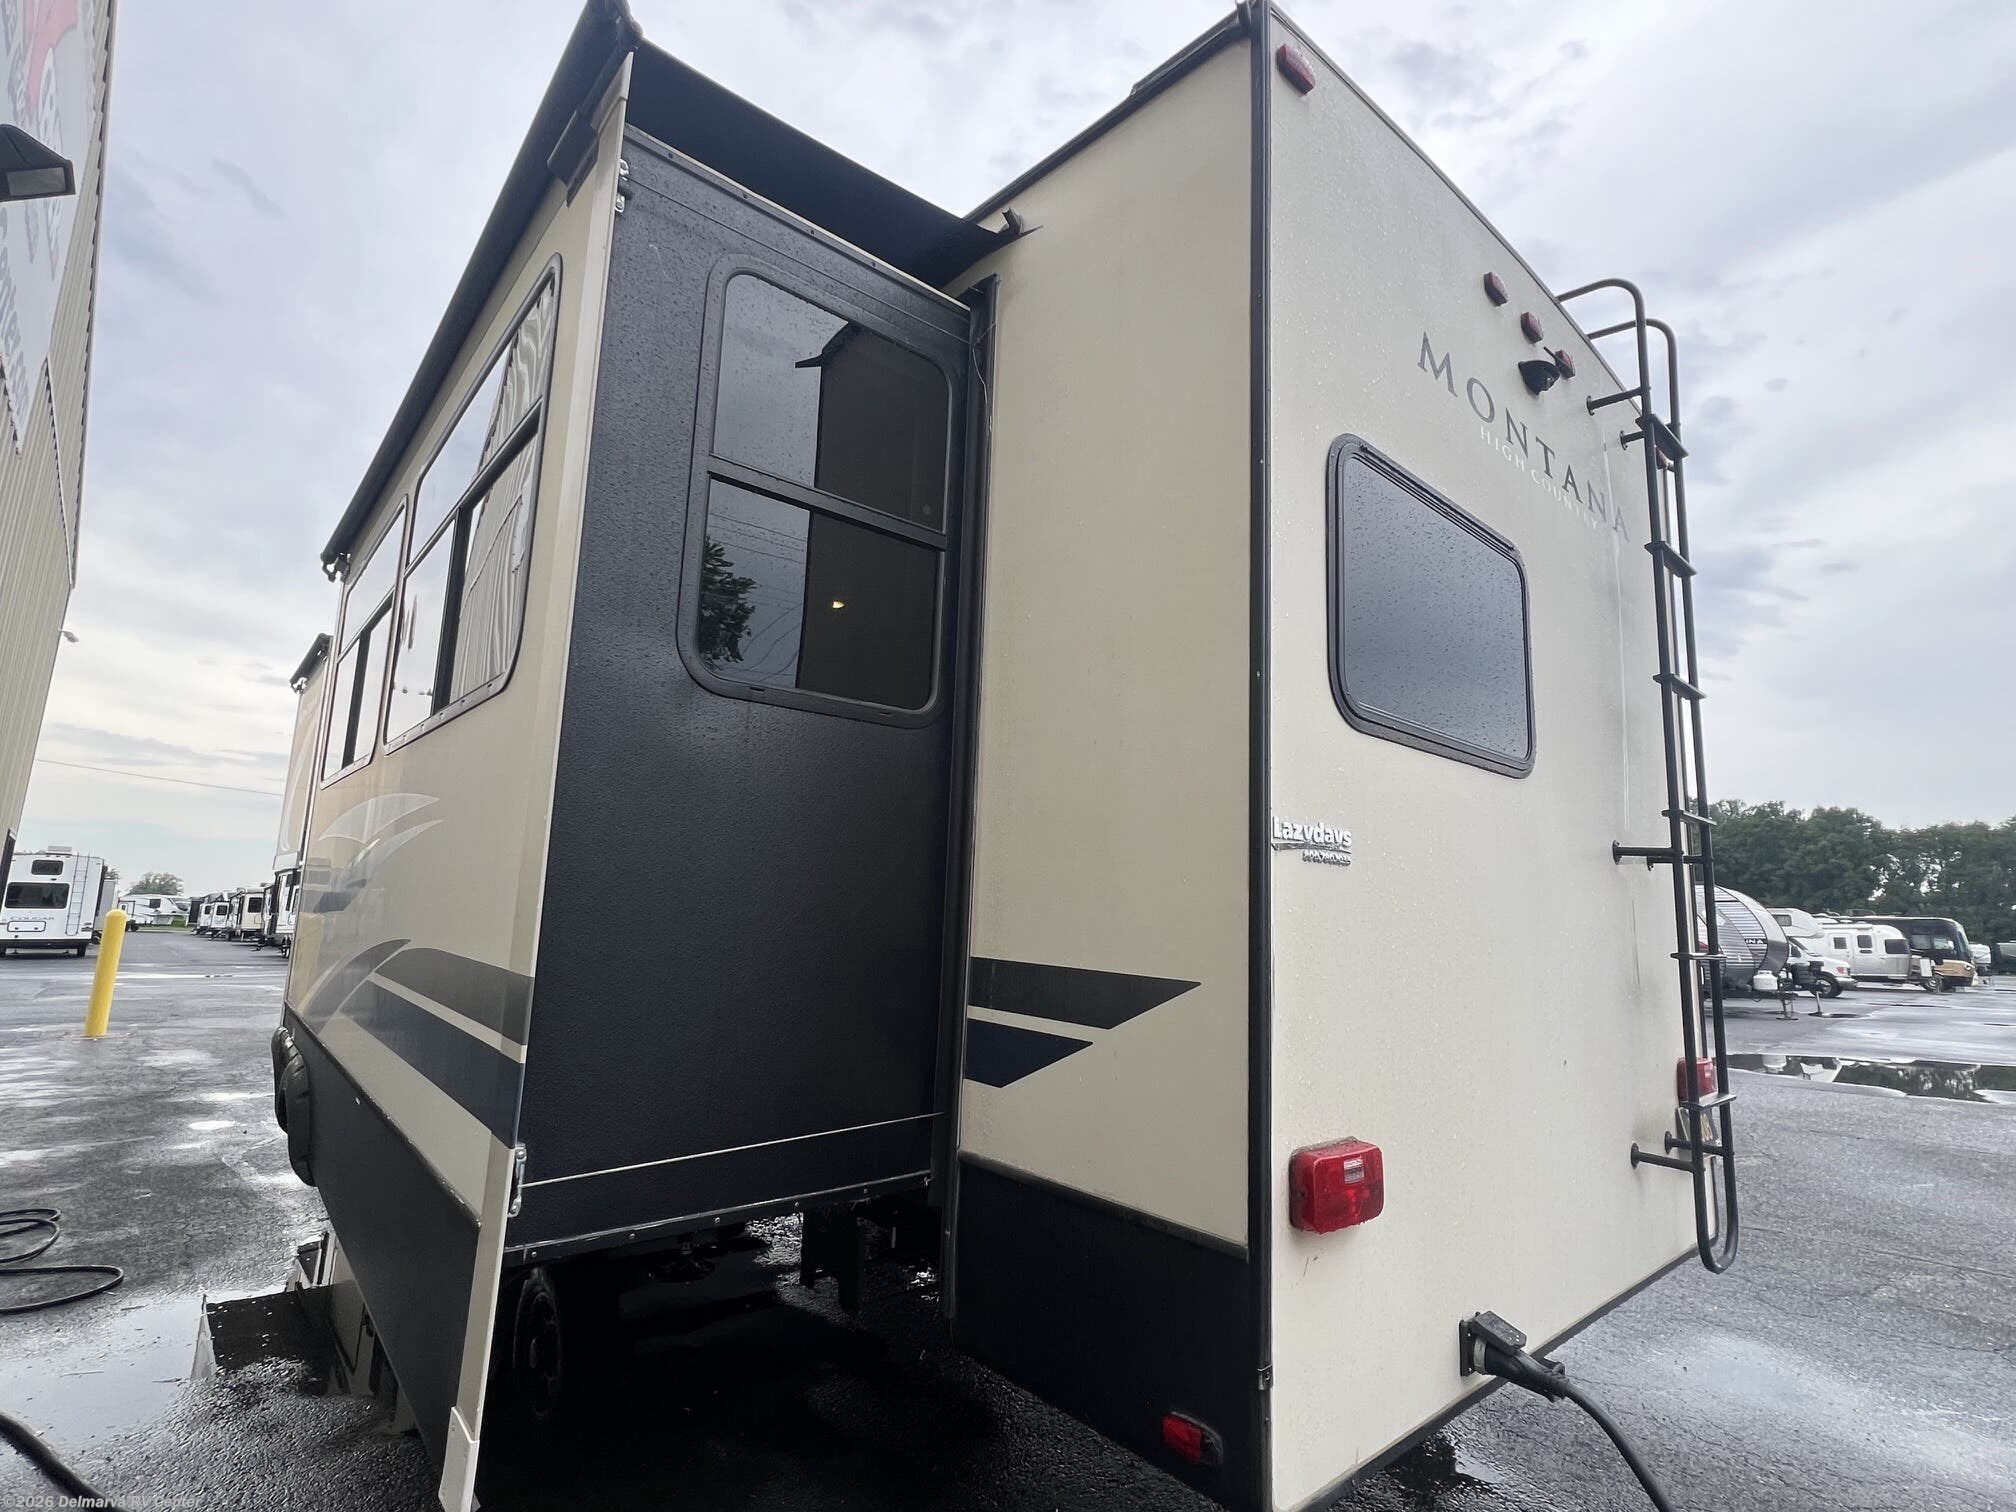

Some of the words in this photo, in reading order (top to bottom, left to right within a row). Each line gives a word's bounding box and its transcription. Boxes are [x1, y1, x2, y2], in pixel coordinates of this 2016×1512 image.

[1417, 331, 1630, 542] MONTANA
[1480, 425, 1525, 472] HIGH
[1531, 469, 1598, 530] COUNTRY
[1273, 816, 1352, 847] Lazydays
